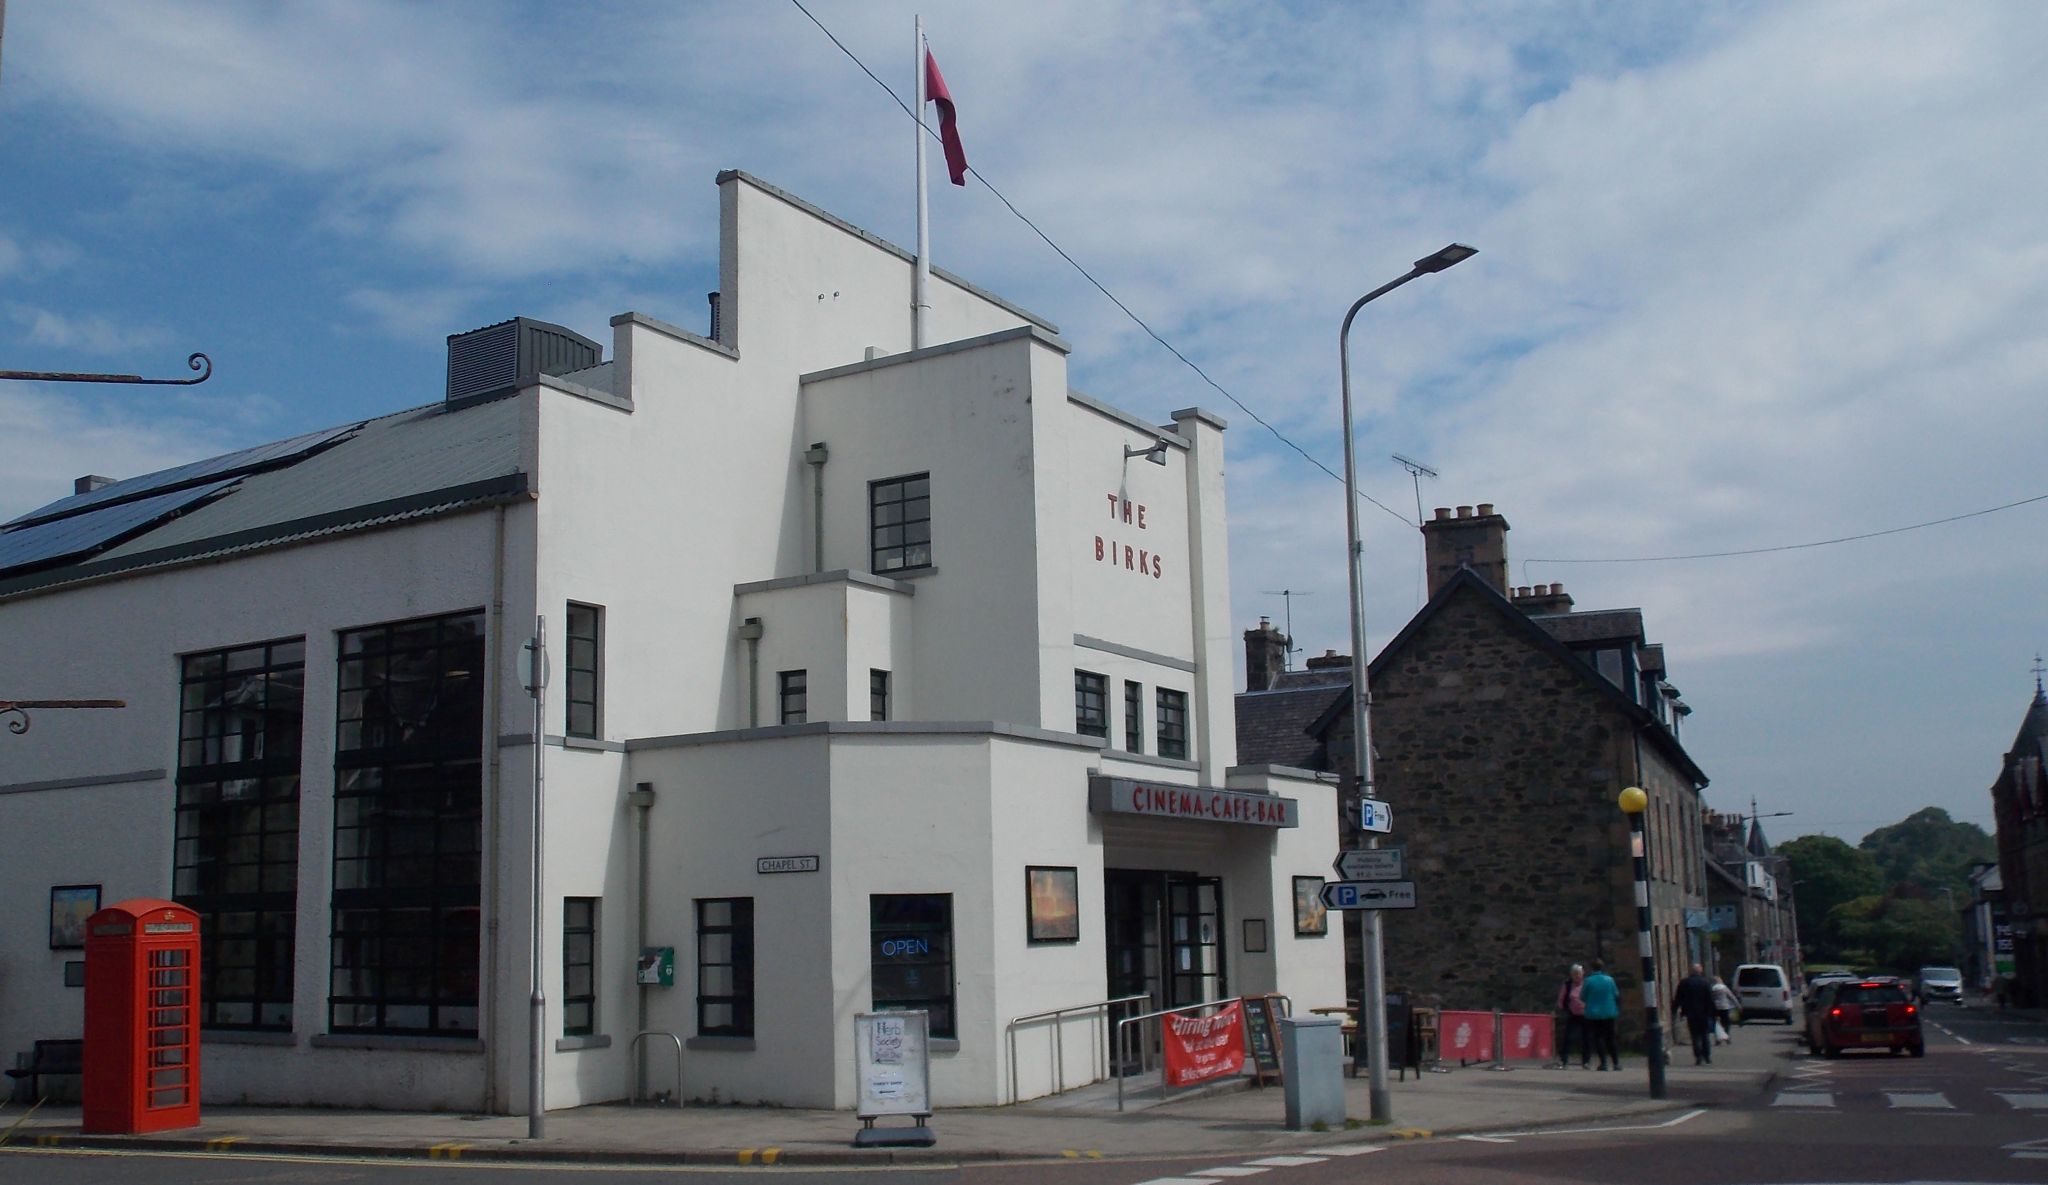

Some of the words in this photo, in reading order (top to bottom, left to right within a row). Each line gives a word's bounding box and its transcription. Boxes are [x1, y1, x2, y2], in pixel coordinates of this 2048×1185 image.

[1107, 493, 1146, 530] THE
[1095, 535, 1162, 579] BIRKS
[761, 859, 796, 871] CHAPEL
[800, 859, 811, 870] ST
[1389, 890, 1411, 899] Free
[882, 939, 928, 956] OPEN
[876, 1021, 901, 1036] Herb
[875, 1036, 903, 1049] Society
